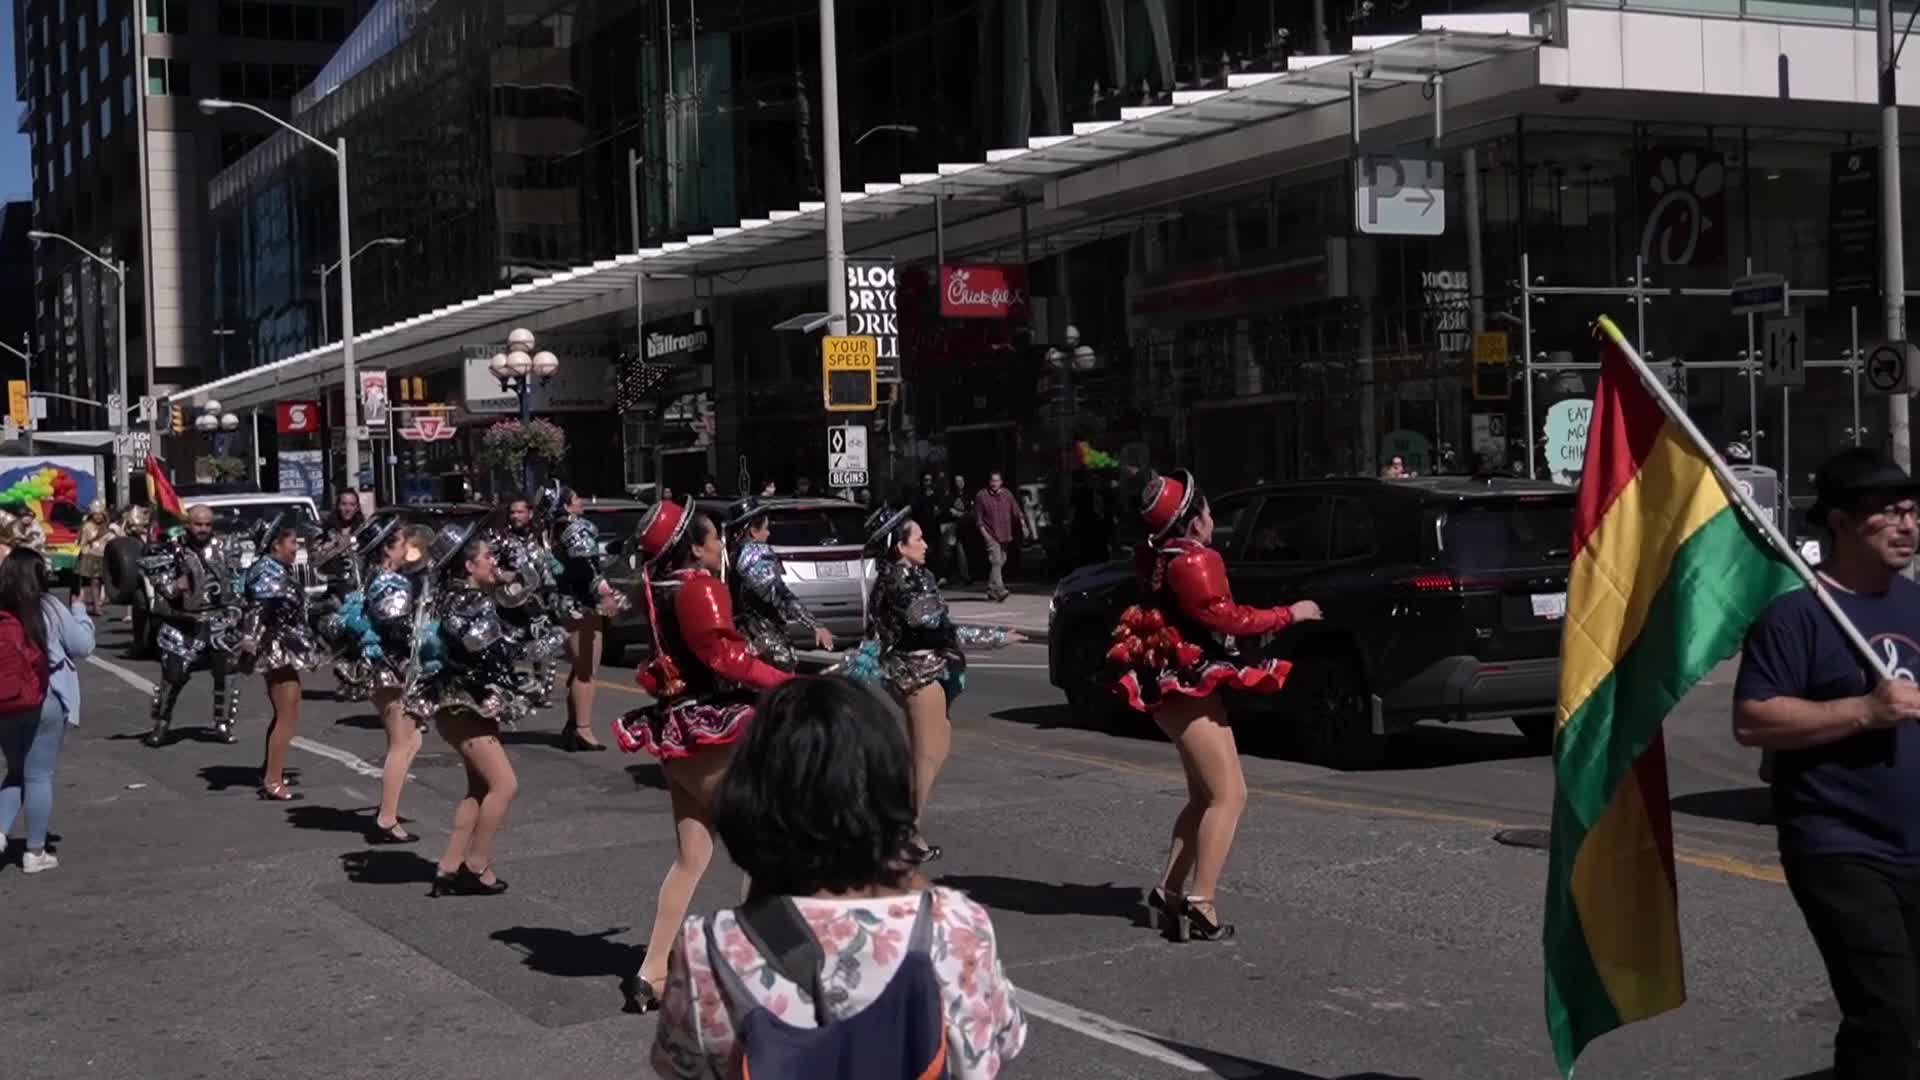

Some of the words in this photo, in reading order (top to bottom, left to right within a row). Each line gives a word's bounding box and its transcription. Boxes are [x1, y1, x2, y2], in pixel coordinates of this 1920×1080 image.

[647, 331, 707, 358] ballroom
[831, 340, 867, 353] YOUR
[828, 354, 870, 366] SPEED
[1568, 407, 1589, 422] EAT
[1567, 424, 1585, 441] MO
[833, 470, 862, 483] BEGINS
